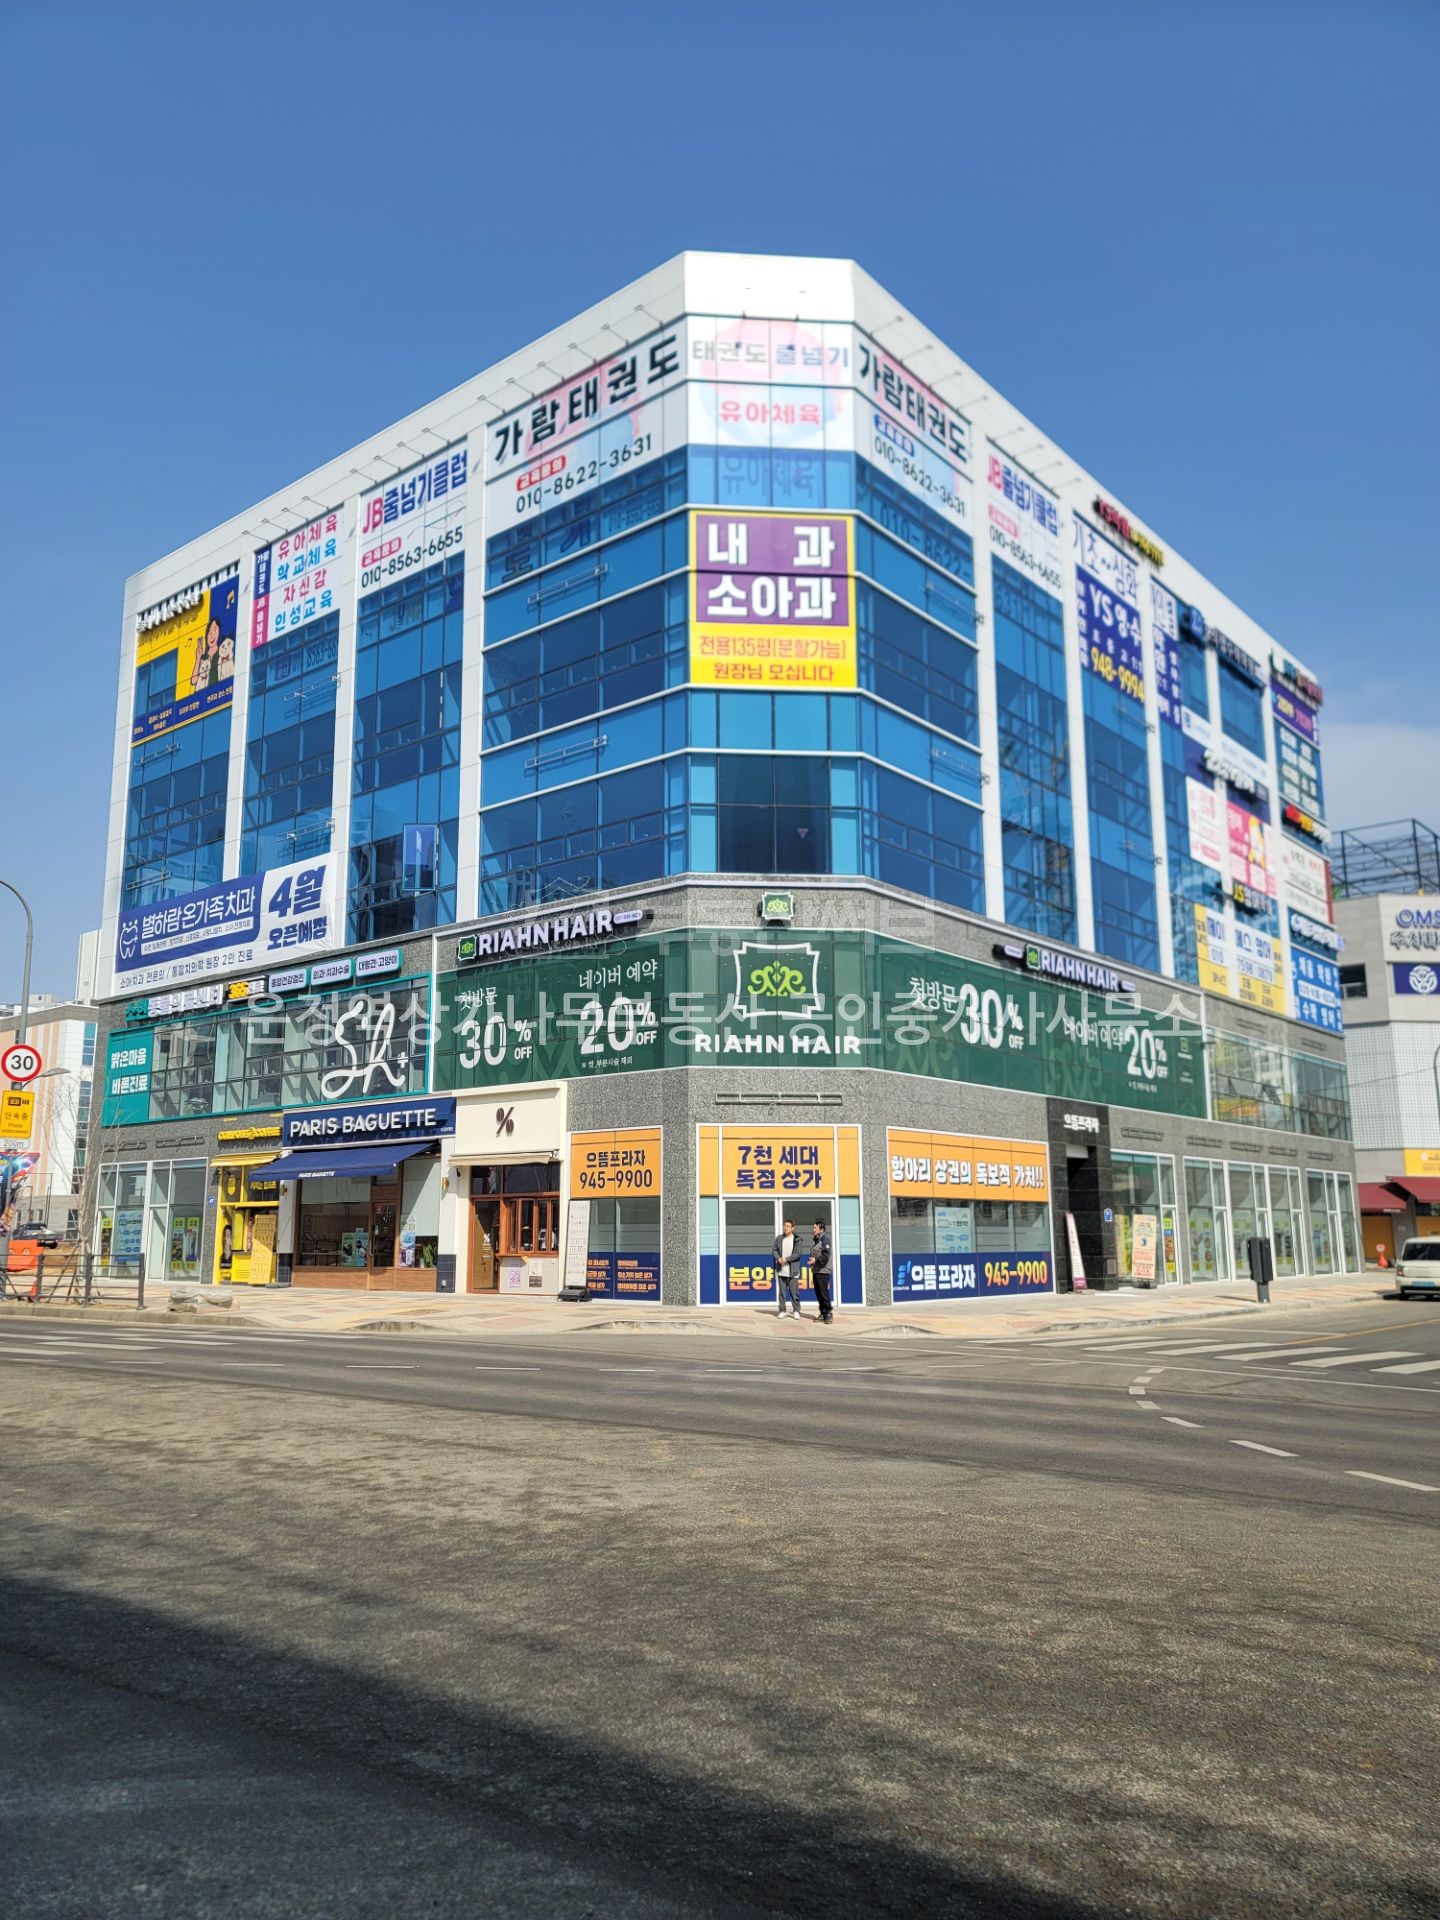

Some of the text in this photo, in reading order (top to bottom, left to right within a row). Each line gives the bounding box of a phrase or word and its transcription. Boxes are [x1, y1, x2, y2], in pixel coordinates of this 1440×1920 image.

[692, 339, 849, 368] 태권도 줄넘기
[495, 333, 681, 462] 가람태권도
[718, 399, 821, 426] 유아체육
[859, 343, 968, 465] 가람태권도
[515, 433, 652, 514] 010-8622-3631
[874, 436, 966, 518] 010-8622-3631
[362, 448, 467, 535] JB줄넘기클럽
[987, 453, 1059, 537] JB줄넘기클럽
[277, 513, 337, 560] 유아체육
[277, 538, 337, 581] 학교체육
[362, 525, 464, 589] 010-8563-6655
[989, 526, 1062, 591] 010-8563-6655
[282, 568, 328, 604] 자신감
[706, 575, 837, 620] 소아과
[275, 589, 332, 632] 인성교육
[1089, 583, 1114, 627] YS
[699, 635, 846, 661] 전용135평(분할가능)
[713, 662, 834, 682] 원장님 모십니다
[268, 864, 327, 918] 4월
[267, 915, 328, 951] 오픈예정
[478, 922, 549, 956] RIAHN
[553, 909, 613, 943] HAIR
[579, 958, 658, 990] 네이버 예약
[1040, 951, 1120, 992] RIAHN HAIR
[909, 977, 958, 1014] 첫방문
[514, 1046, 533, 1060] OFF
[636, 1031, 657, 1046] OFF
[694, 1034, 862, 1054] RIAHN HAIR
[1008, 1034, 1024, 1050] OFF
[11, 1055, 34, 1071] 30
[1156, 1066, 1169, 1080] OFF
[112, 1075, 148, 1095] 바른진료
[290, 1108, 436, 1138] PARIS BAGUETTE
[586, 1149, 646, 1169] 으뜸프라자
[737, 1144, 819, 1166] 7천 세대
[579, 1169, 653, 1190] 945-9900
[736, 1169, 822, 1190] 독점 상가
[891, 1155, 1045, 1188] 항아리 상권의 독보적 가치!!
[728, 1266, 774, 1290] 분양
[911, 1264, 976, 1291] 으뜸프라자
[984, 1260, 1048, 1287] 945-9900
